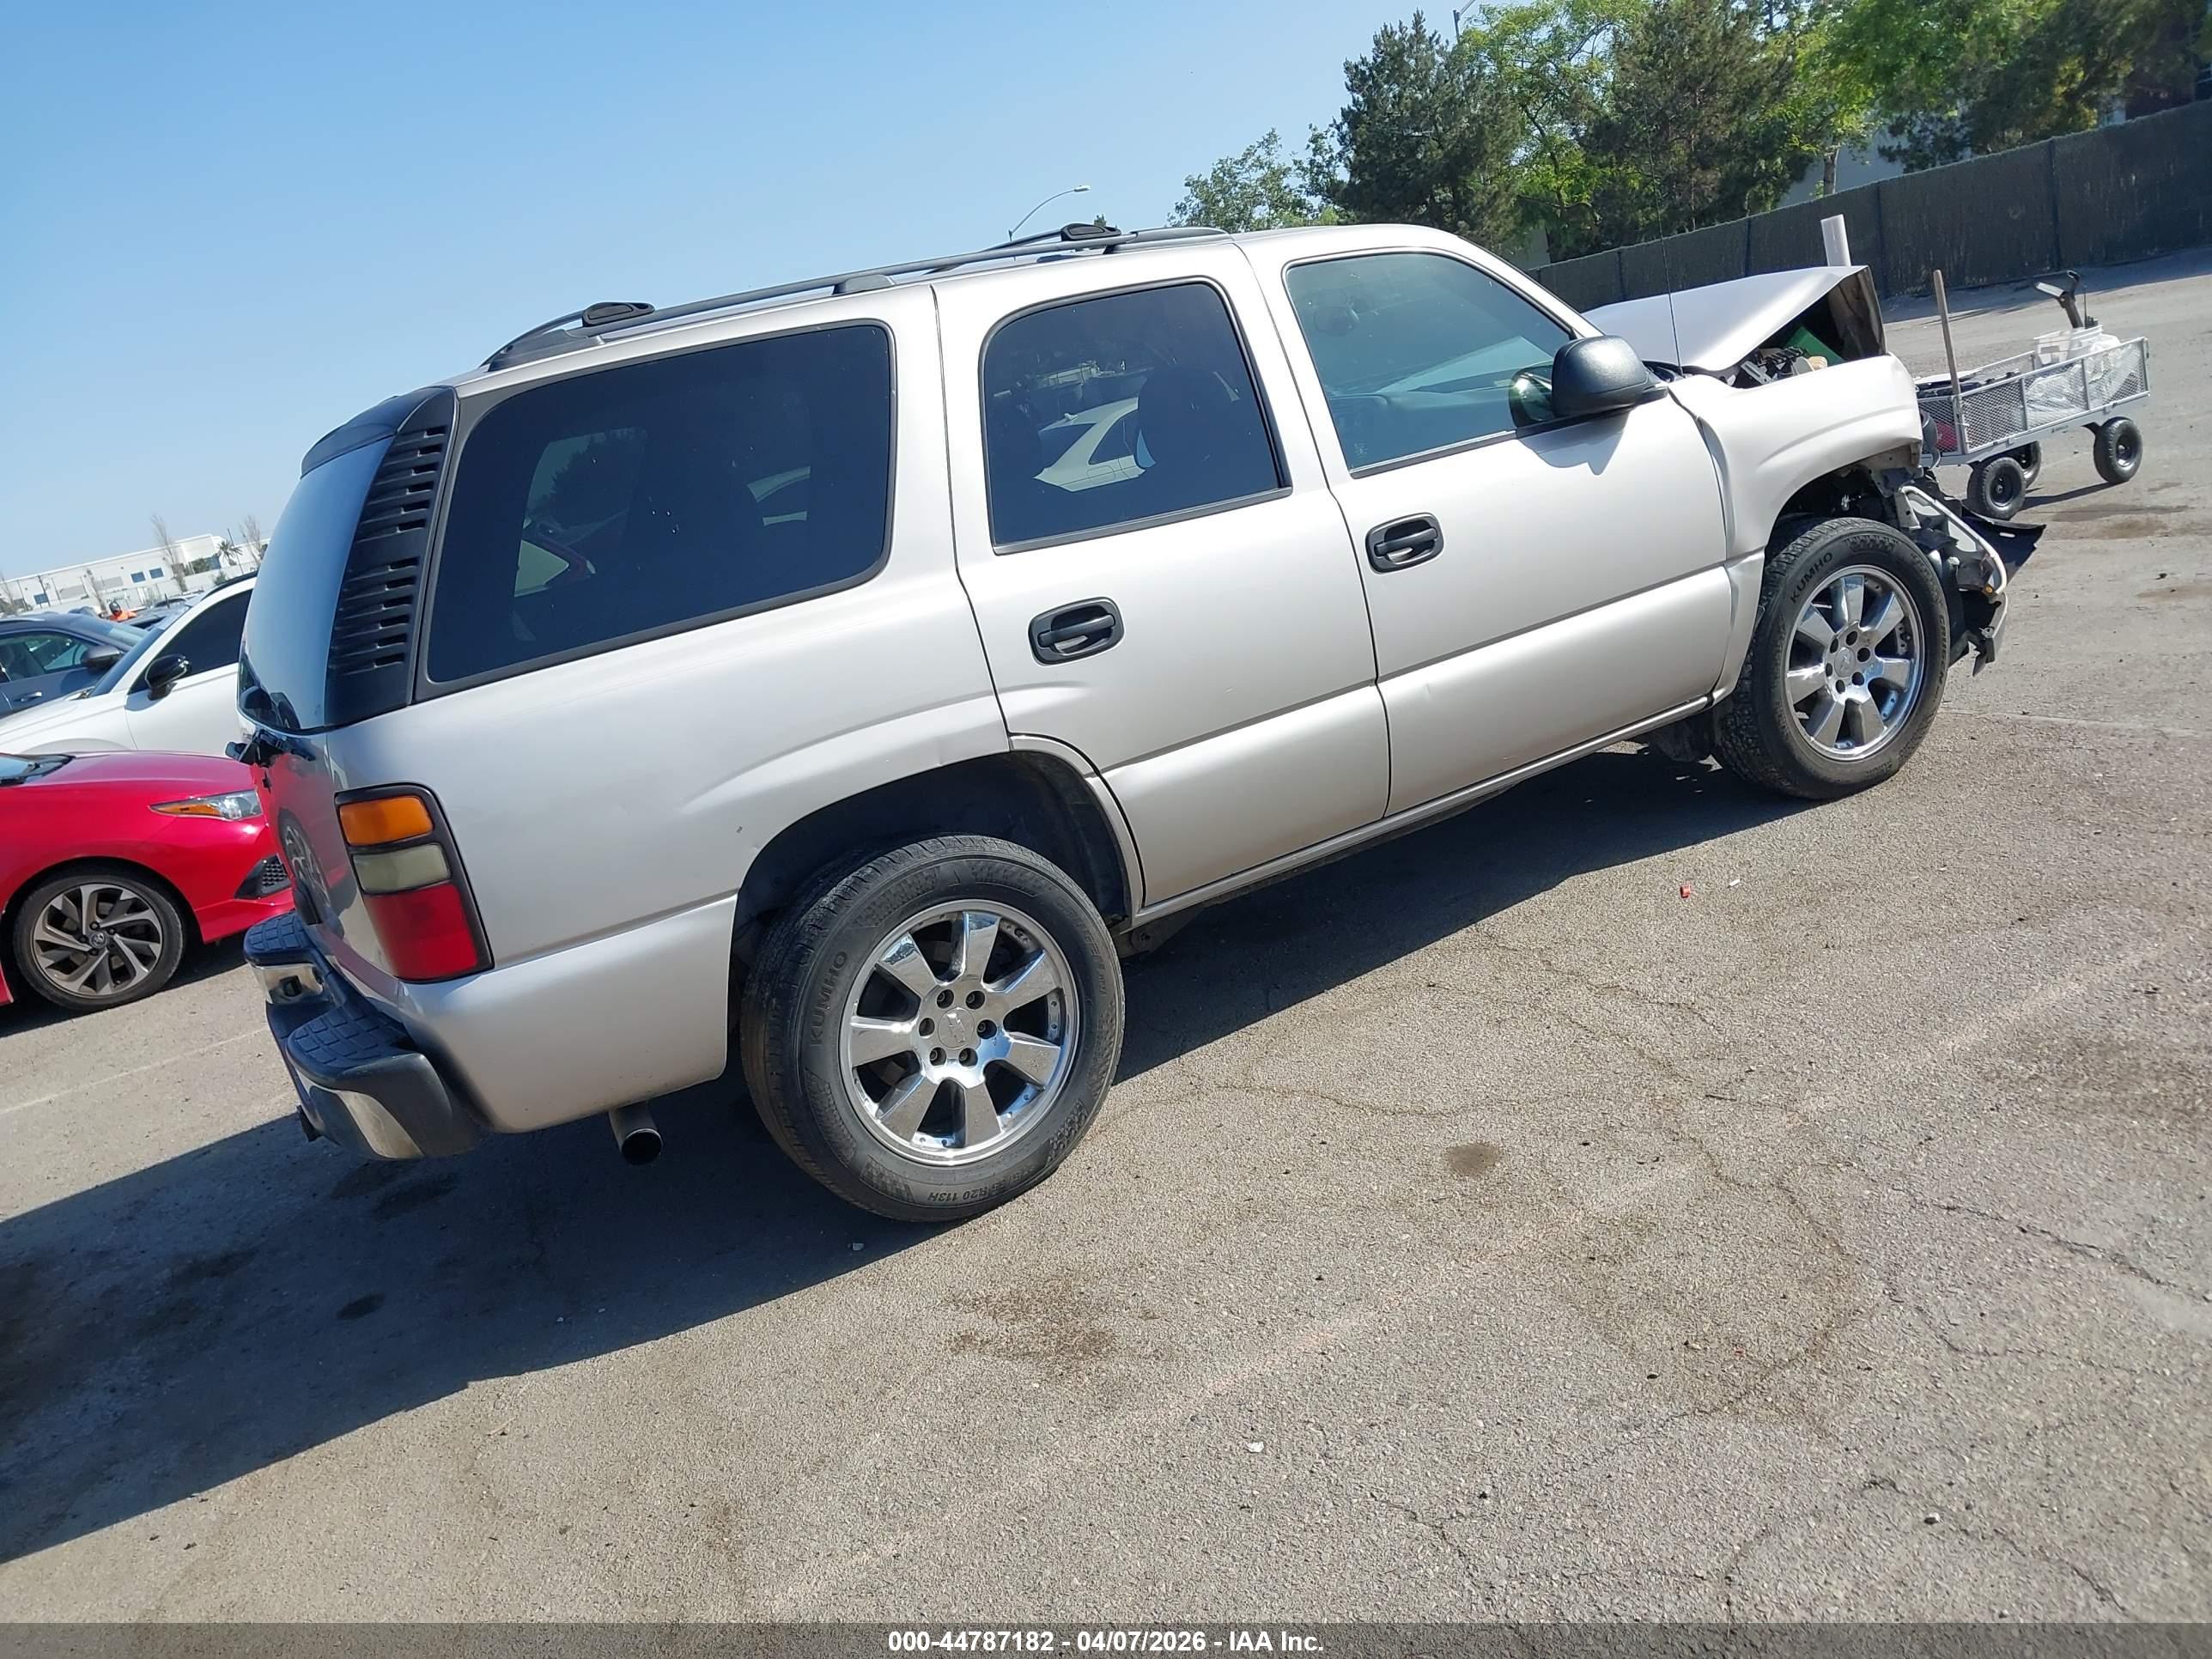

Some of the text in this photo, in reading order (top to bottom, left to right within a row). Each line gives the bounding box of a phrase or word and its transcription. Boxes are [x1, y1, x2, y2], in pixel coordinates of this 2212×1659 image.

[1790, 551, 1833, 605] KUMHO
[810, 950, 848, 1047] KUMHO
[927, 1192, 959, 1202] 113H
